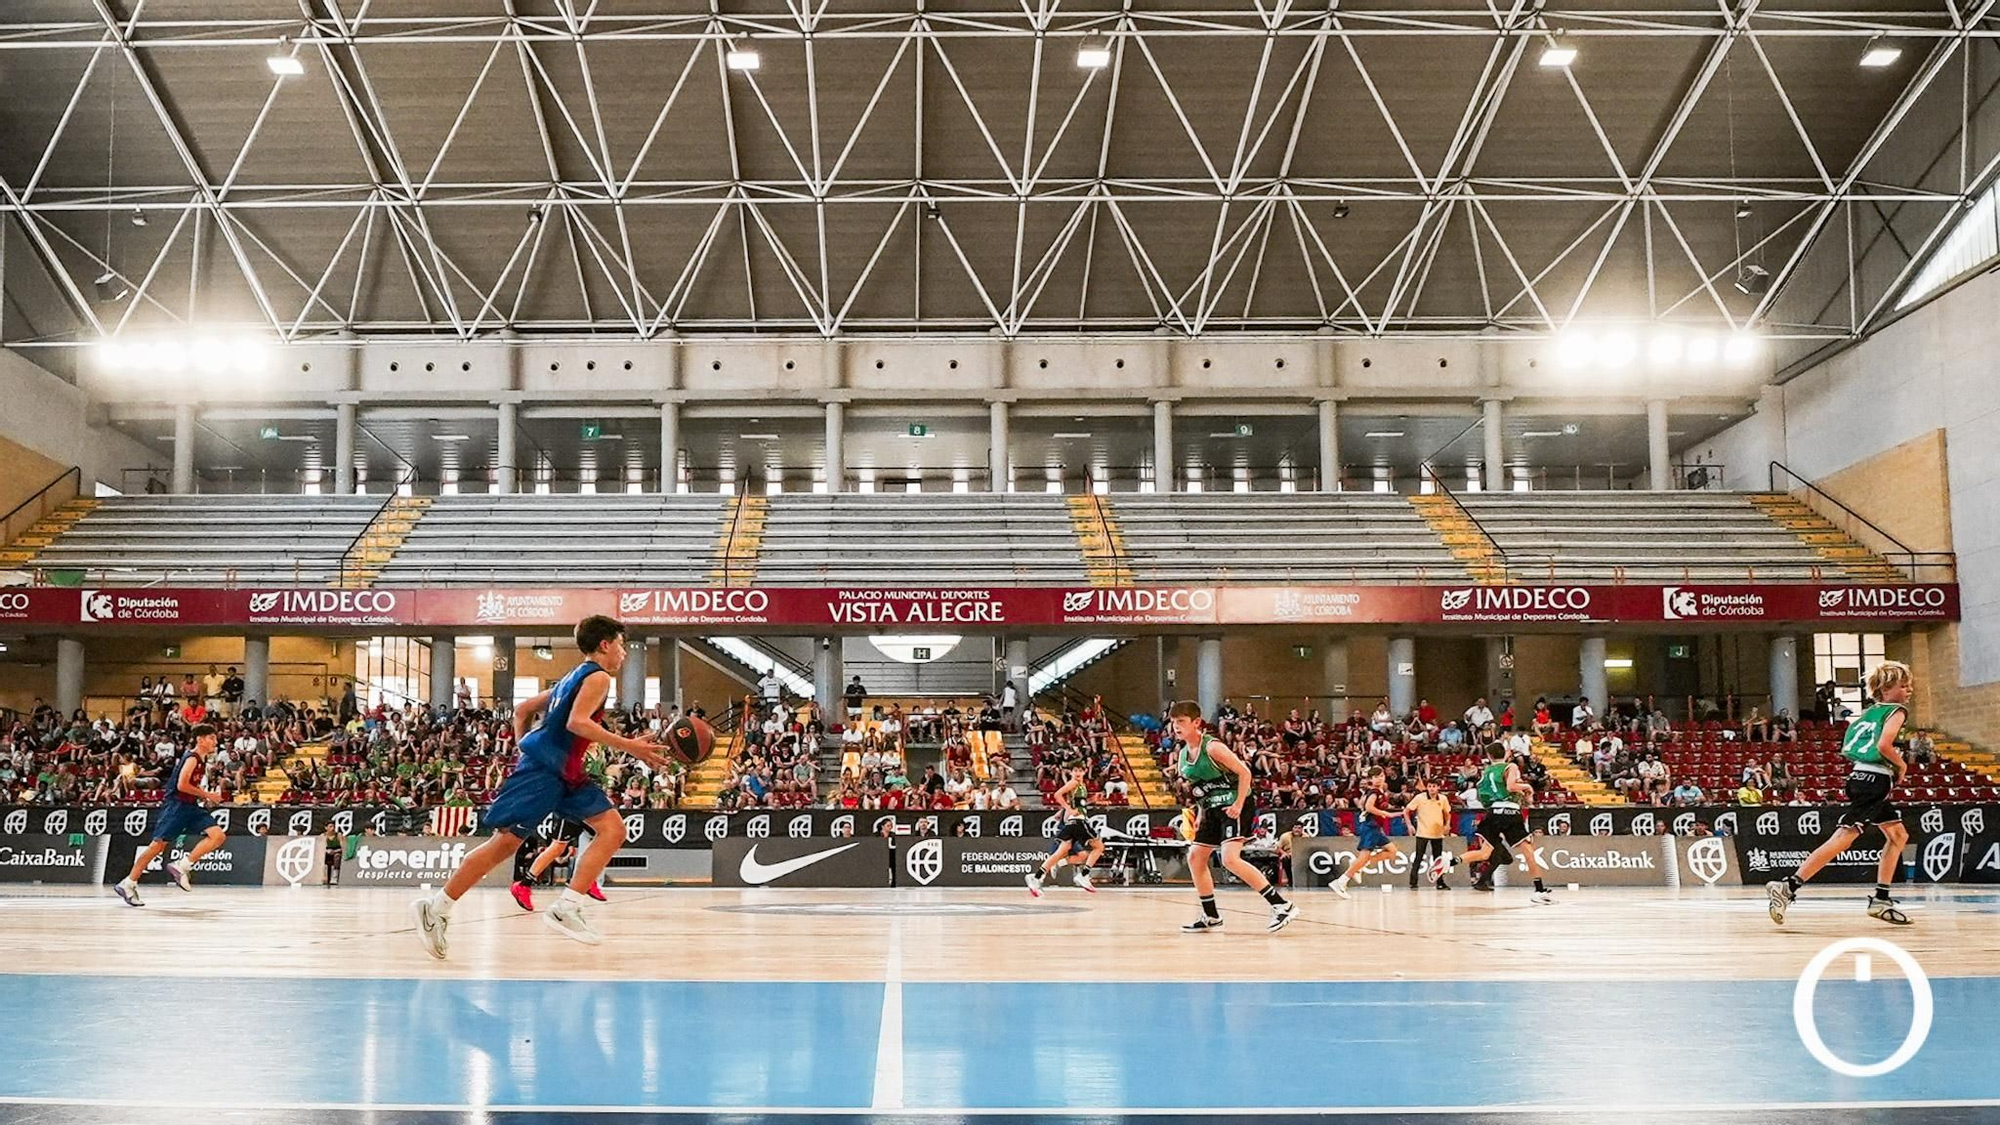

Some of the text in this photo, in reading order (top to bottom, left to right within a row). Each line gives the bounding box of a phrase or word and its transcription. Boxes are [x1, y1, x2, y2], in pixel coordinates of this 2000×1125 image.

[586, 427, 594, 437] 7
[913, 425, 921, 435] 8
[1240, 425, 1248, 435] 9
[507, 596, 563, 606] AYUNTAMIENTO
[654, 590, 768, 612] IMDECO
[839, 591, 990, 600] PALACIO MUNICIPAL DEPORTES
[1098, 589, 1212, 611] IMDECO
[1476, 588, 1590, 609] IMDECO
[1701, 594, 1763, 606] Diputación
[1848, 588, 1946, 607] IMDECO
[118, 596, 179, 608] Diputación
[283, 591, 396, 612] IMDECO
[118, 607, 179, 619] de Córdoba
[827, 602, 1005, 622] VISTA ALEGRE
[1702, 605, 1764, 616] de Córdoba
[281, 616, 316, 624] Municipal
[652, 616, 688, 624] Municipal
[700, 616, 734, 624] Deportes
[735, 615, 767, 623] Córdoba
[1096, 615, 1132, 623] Municipal
[1522, 613, 1556, 621] Deportes
[1557, 612, 1590, 620] Córdoba
[918, 649, 927, 658] H
[1675, 646, 1683, 656] J
[0, 846, 86, 867] CaixaBank
[357, 842, 466, 869] tenerif
[961, 851, 1015, 861] FEDERACIÓN
[1551, 850, 1656, 869] CaixaBank
[961, 864, 1032, 873] DE BALONCESTO
[356, 869, 413, 880] despierta
